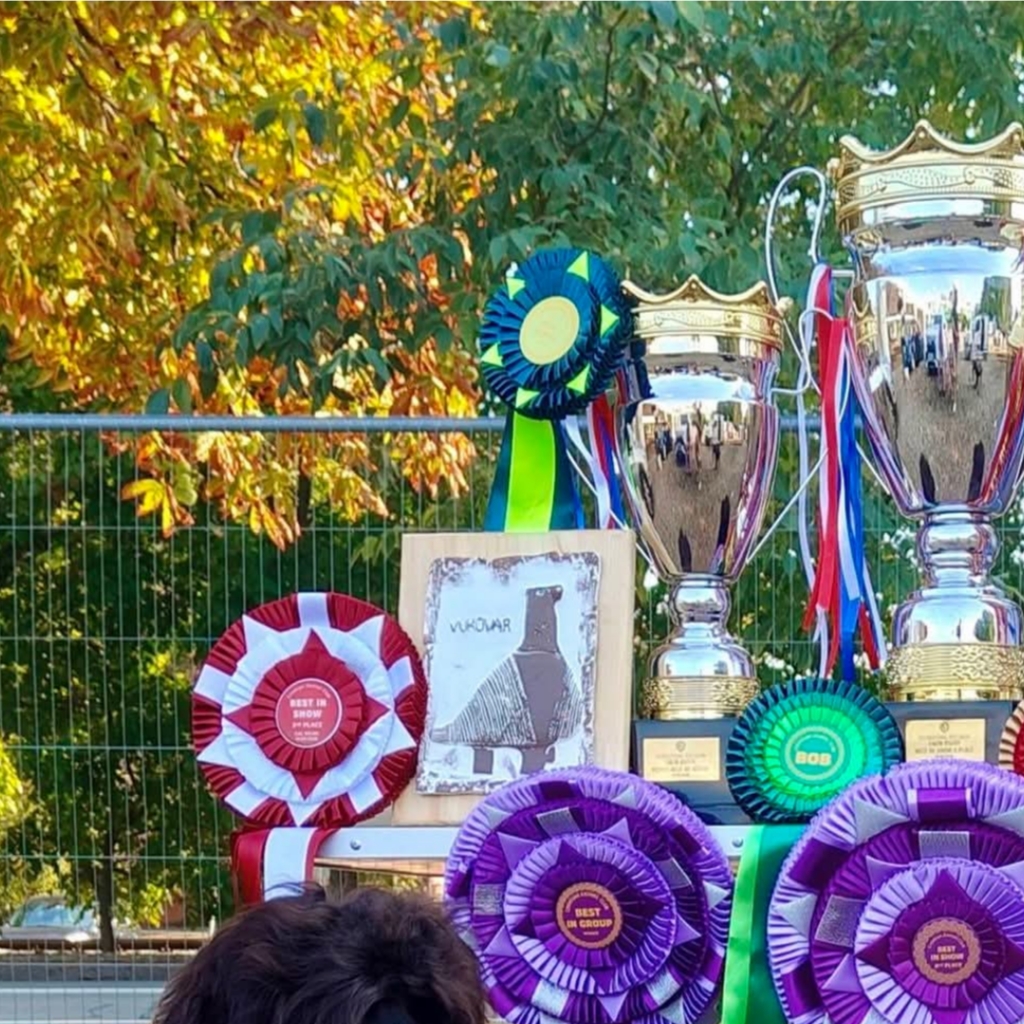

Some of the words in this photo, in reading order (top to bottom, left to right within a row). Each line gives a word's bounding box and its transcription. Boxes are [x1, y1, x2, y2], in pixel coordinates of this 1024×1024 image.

[450, 616, 512, 633] VUKOVAR
[290, 698, 314, 707] BEST
[316, 698, 327, 707] IN
[293, 709, 323, 719] SHOW
[795, 750, 832, 767] BOB
[575, 908, 601, 918] BEST
[566, 920, 578, 929] IN
[579, 918, 613, 928] GROUP
[937, 945, 956, 953] BEST
[930, 953, 940, 962] IN
[940, 952, 964, 961] SHOW
